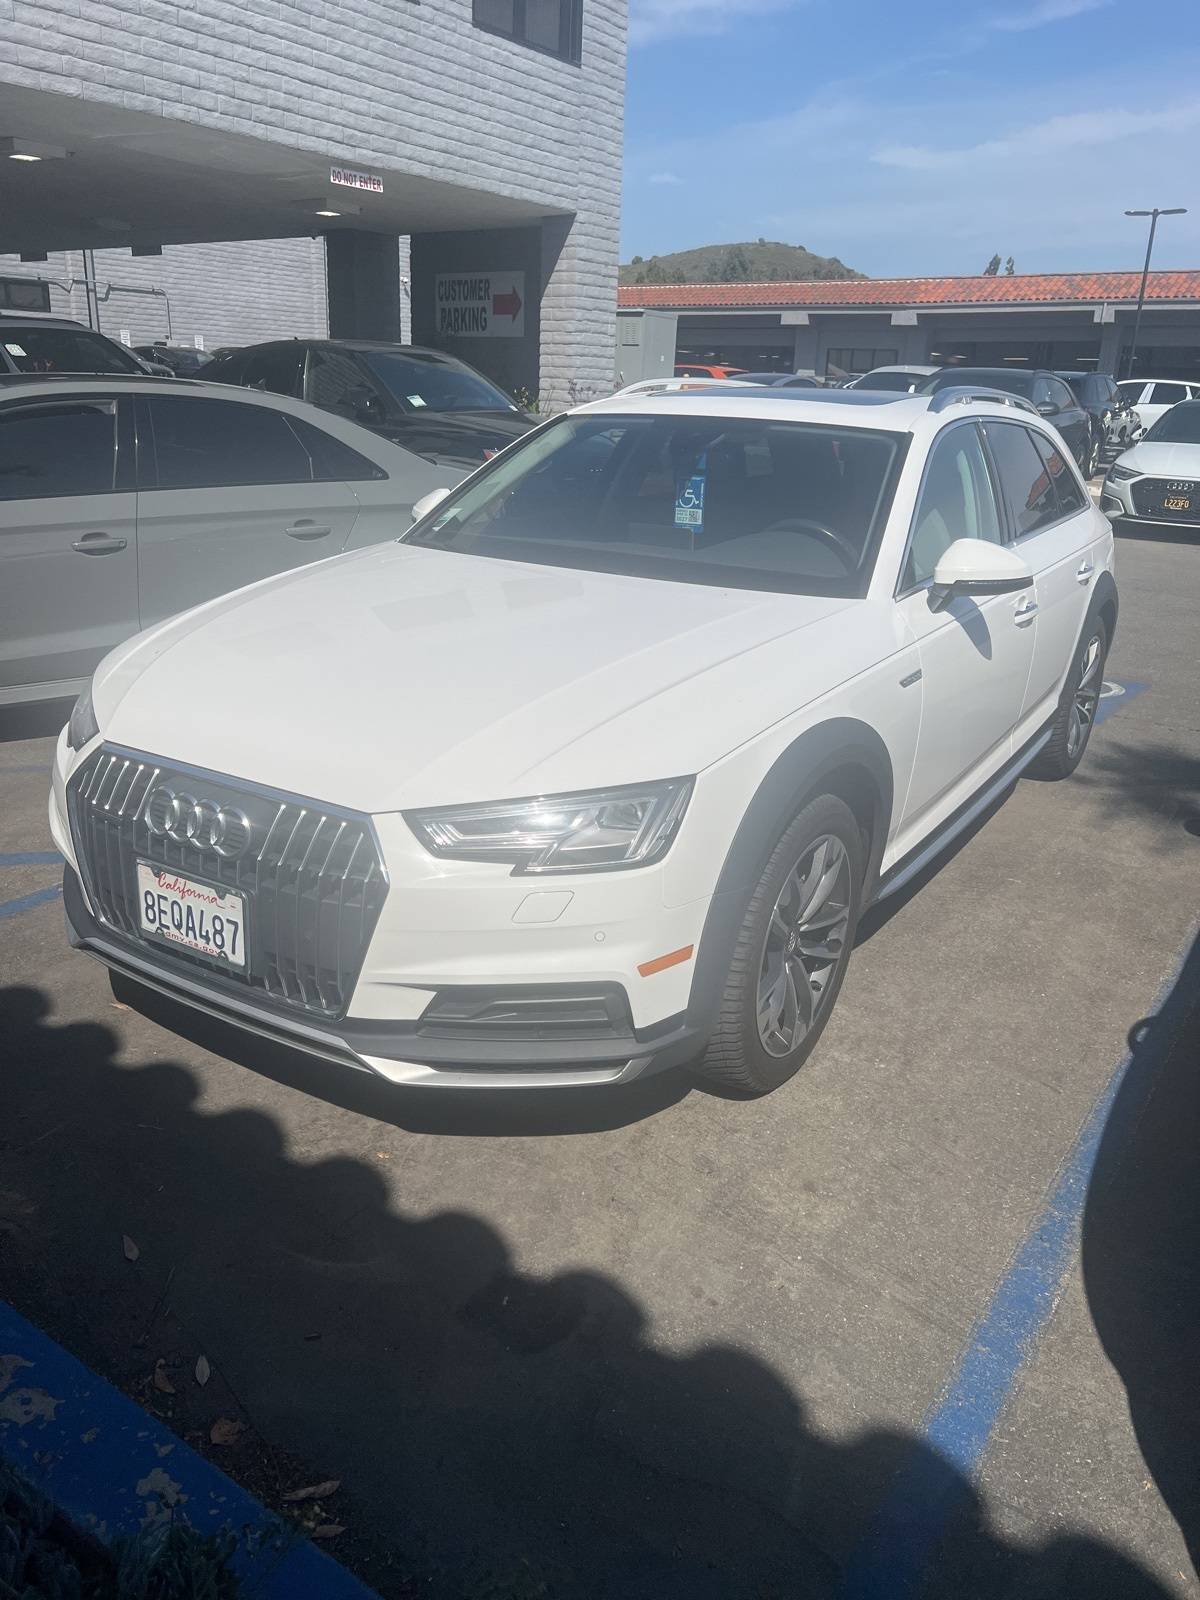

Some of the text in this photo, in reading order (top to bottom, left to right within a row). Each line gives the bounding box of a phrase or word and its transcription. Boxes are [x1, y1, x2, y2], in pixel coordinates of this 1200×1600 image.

[332, 169, 382, 191] DO NOT ENTER
[438, 279, 491, 302] CUSTOMER
[440, 306, 488, 332] PARKING
[157, 871, 226, 910] California
[144, 889, 239, 956] 8EQA487
